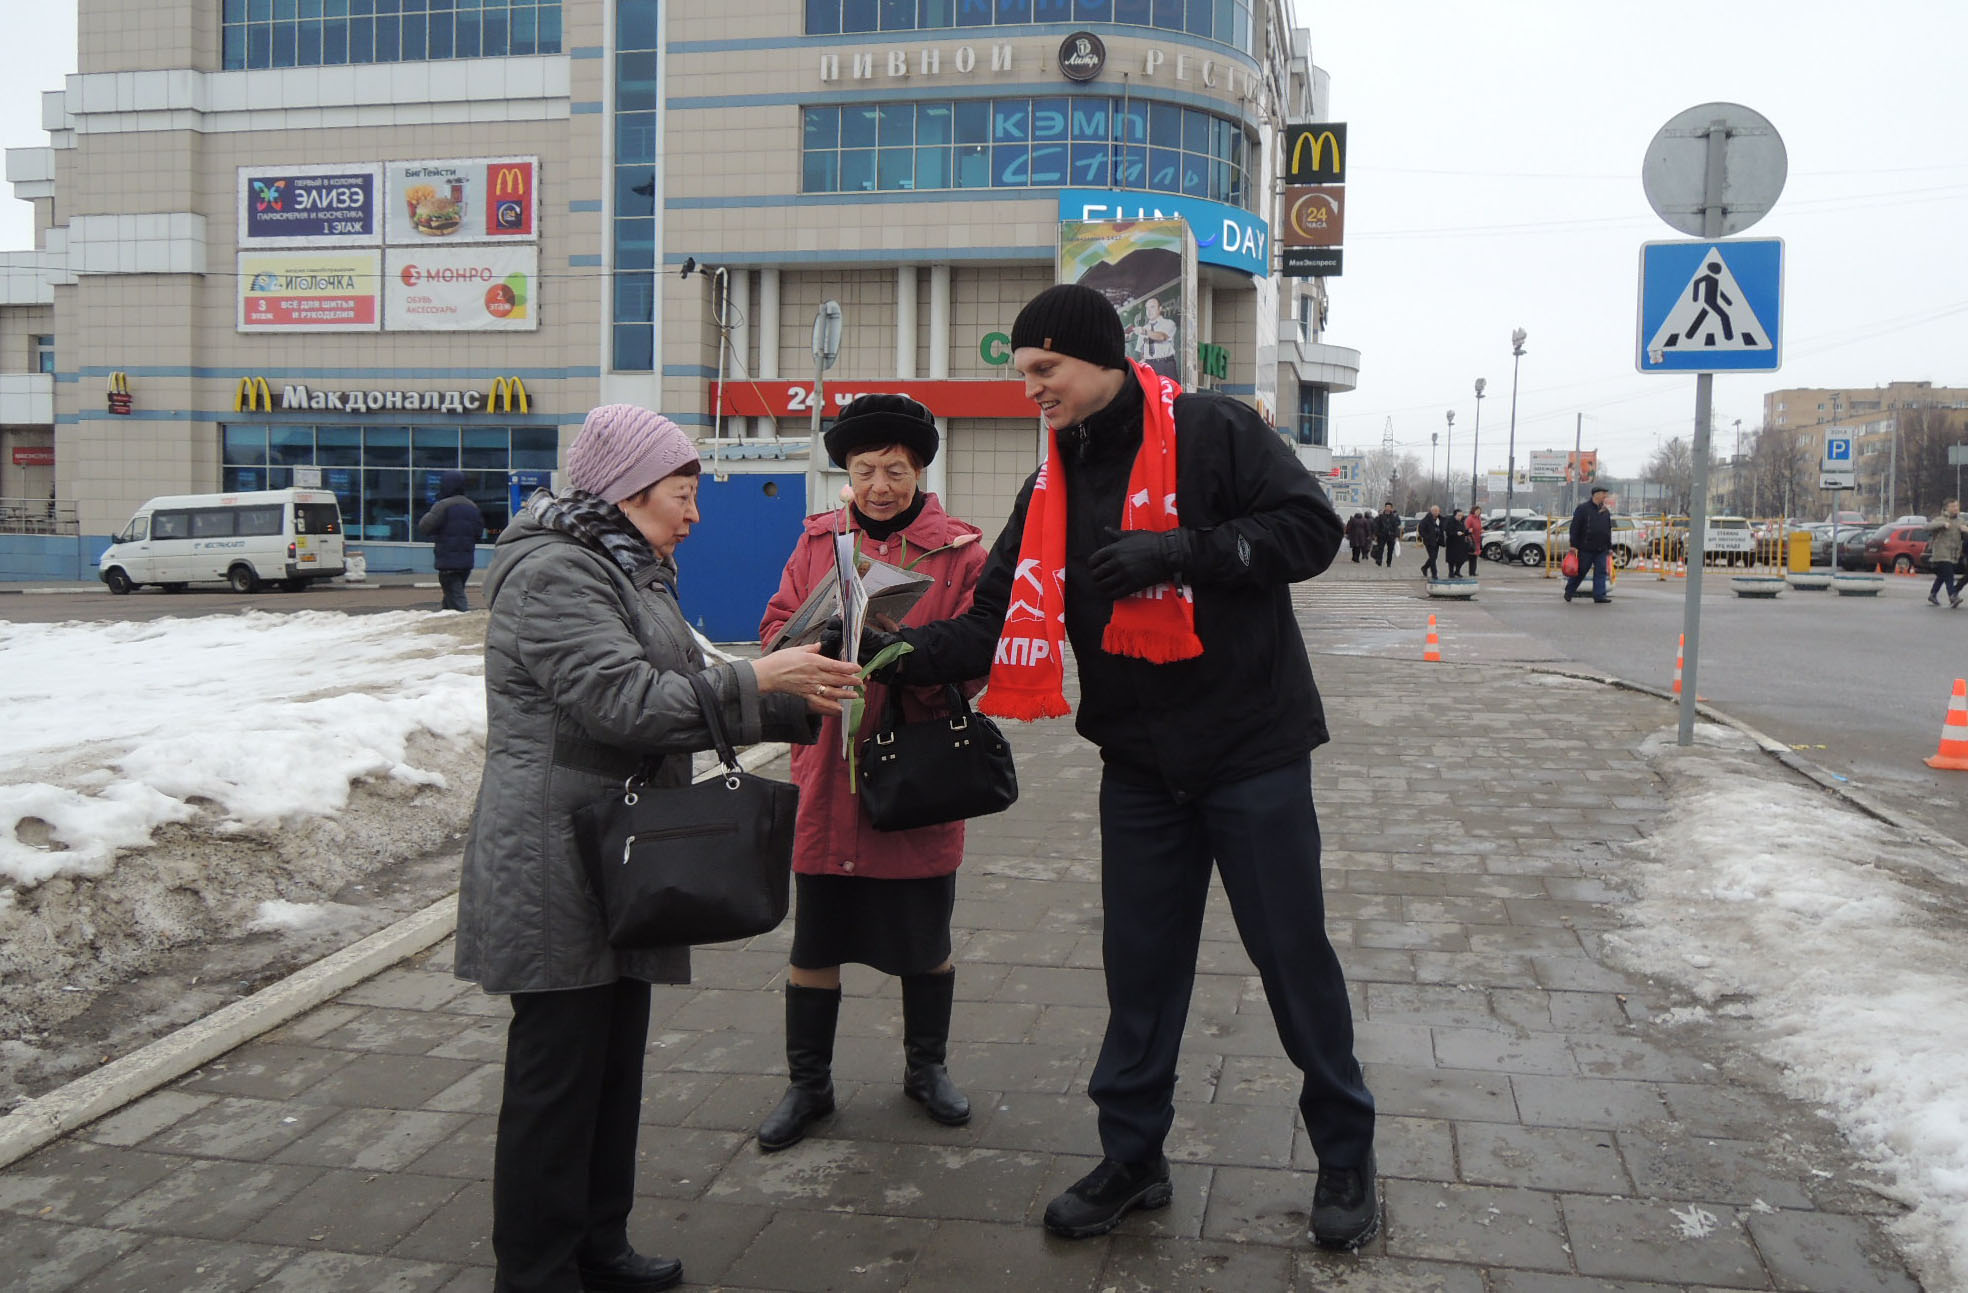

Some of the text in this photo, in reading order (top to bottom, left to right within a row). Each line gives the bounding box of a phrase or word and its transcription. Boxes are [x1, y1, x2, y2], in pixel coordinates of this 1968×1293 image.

[820, 40, 1013, 80] ПИВНОЙ
[1065, 52, 1099, 68] Литр
[995, 111, 1144, 139] КЭМП
[405, 167, 457, 178] Биг Тейсти
[294, 187, 364, 209] ЭЛИЗЭ
[256, 212, 309, 221] ПАРФЮМЕРИЯ
[317, 210, 364, 219] КОСМЕТИКА
[1306, 207, 1328, 223] 24
[332, 221, 363, 233] ЭТАЖ
[1222, 218, 1266, 261] DAY
[426, 267, 493, 283] МОНРО
[496, 290, 504, 300] 2
[258, 299, 267, 311] 3
[281, 384, 481, 414] Макдоналдс
[1832, 440, 1847, 459] P
[994, 637, 1054, 667] КПР
